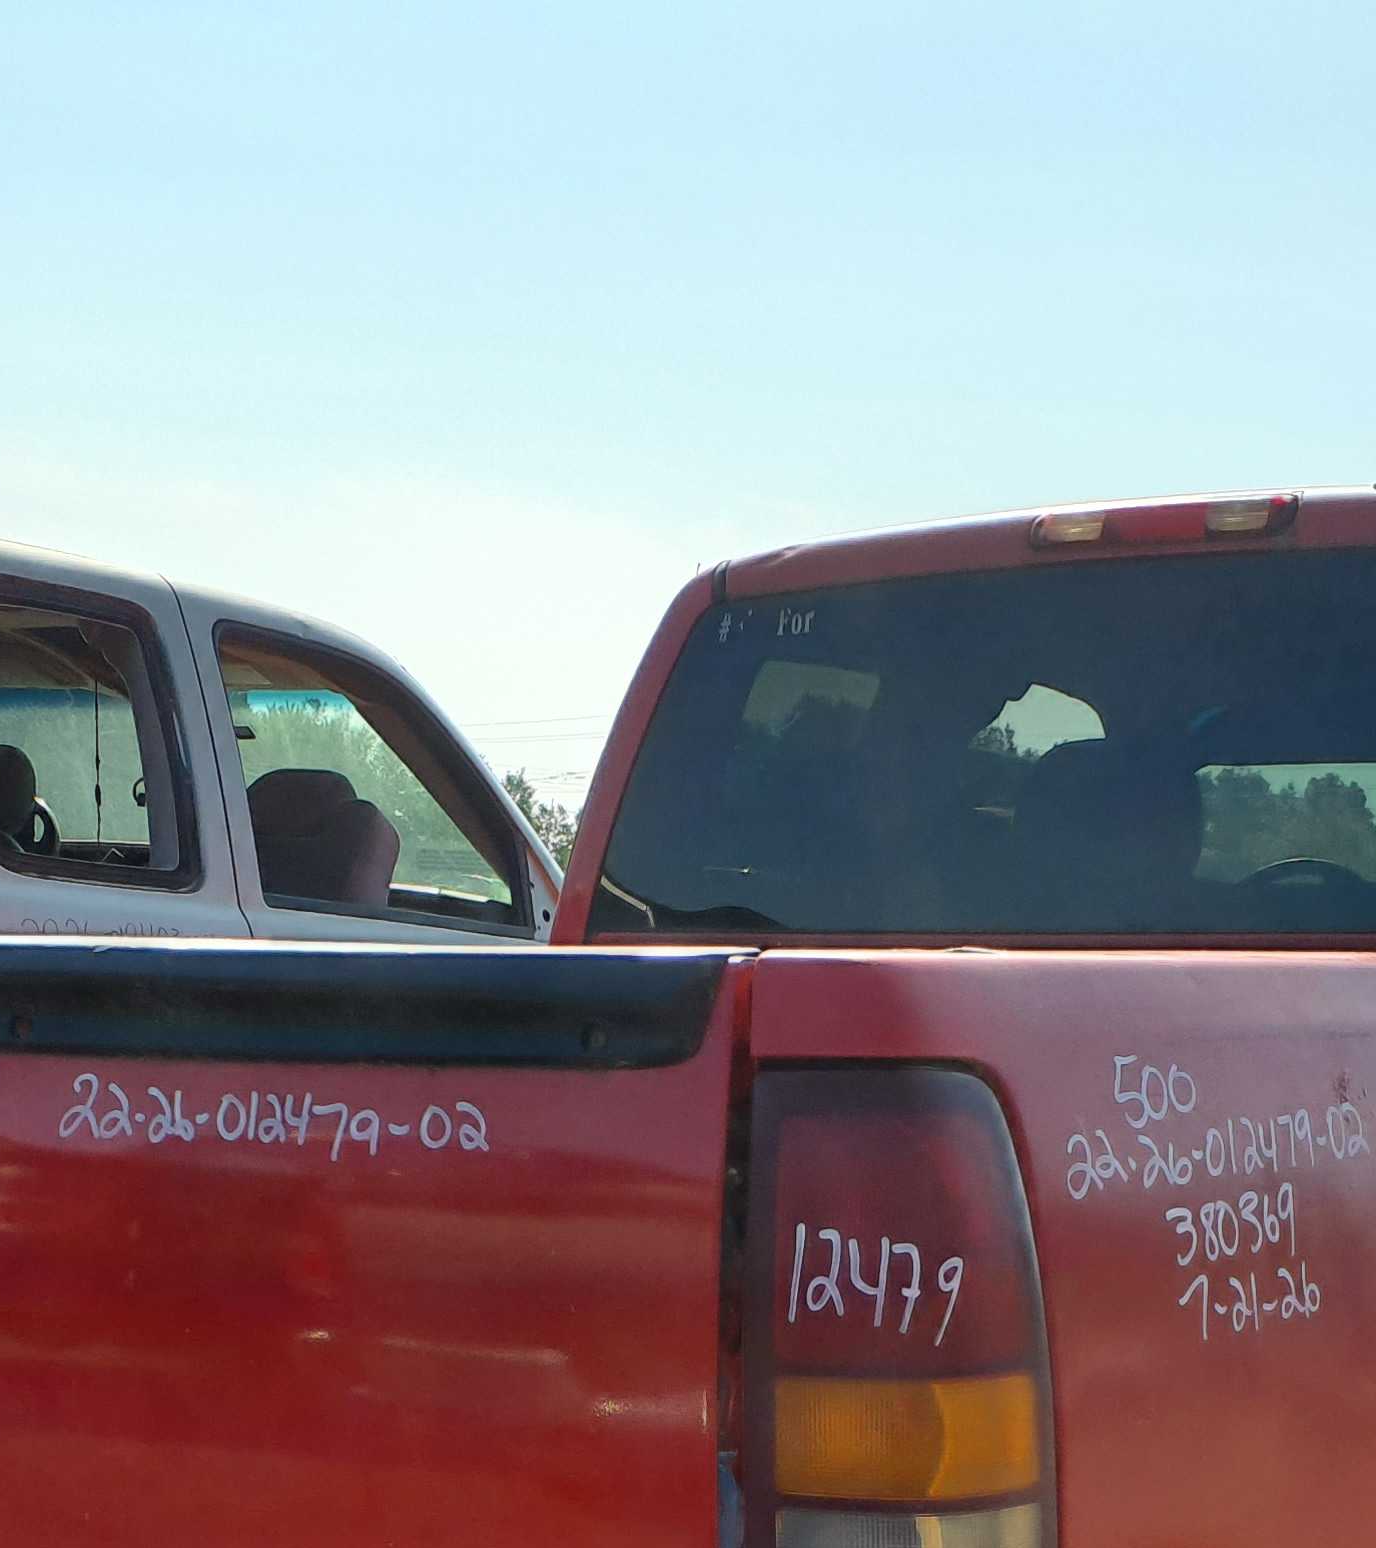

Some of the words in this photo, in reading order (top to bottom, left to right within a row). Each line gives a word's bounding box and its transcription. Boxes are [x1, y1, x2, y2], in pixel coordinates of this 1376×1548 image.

[1112, 1054, 1198, 1130] 500
[1165, 1181, 1296, 1267] 380369
[787, 1221, 965, 1347] 12479
